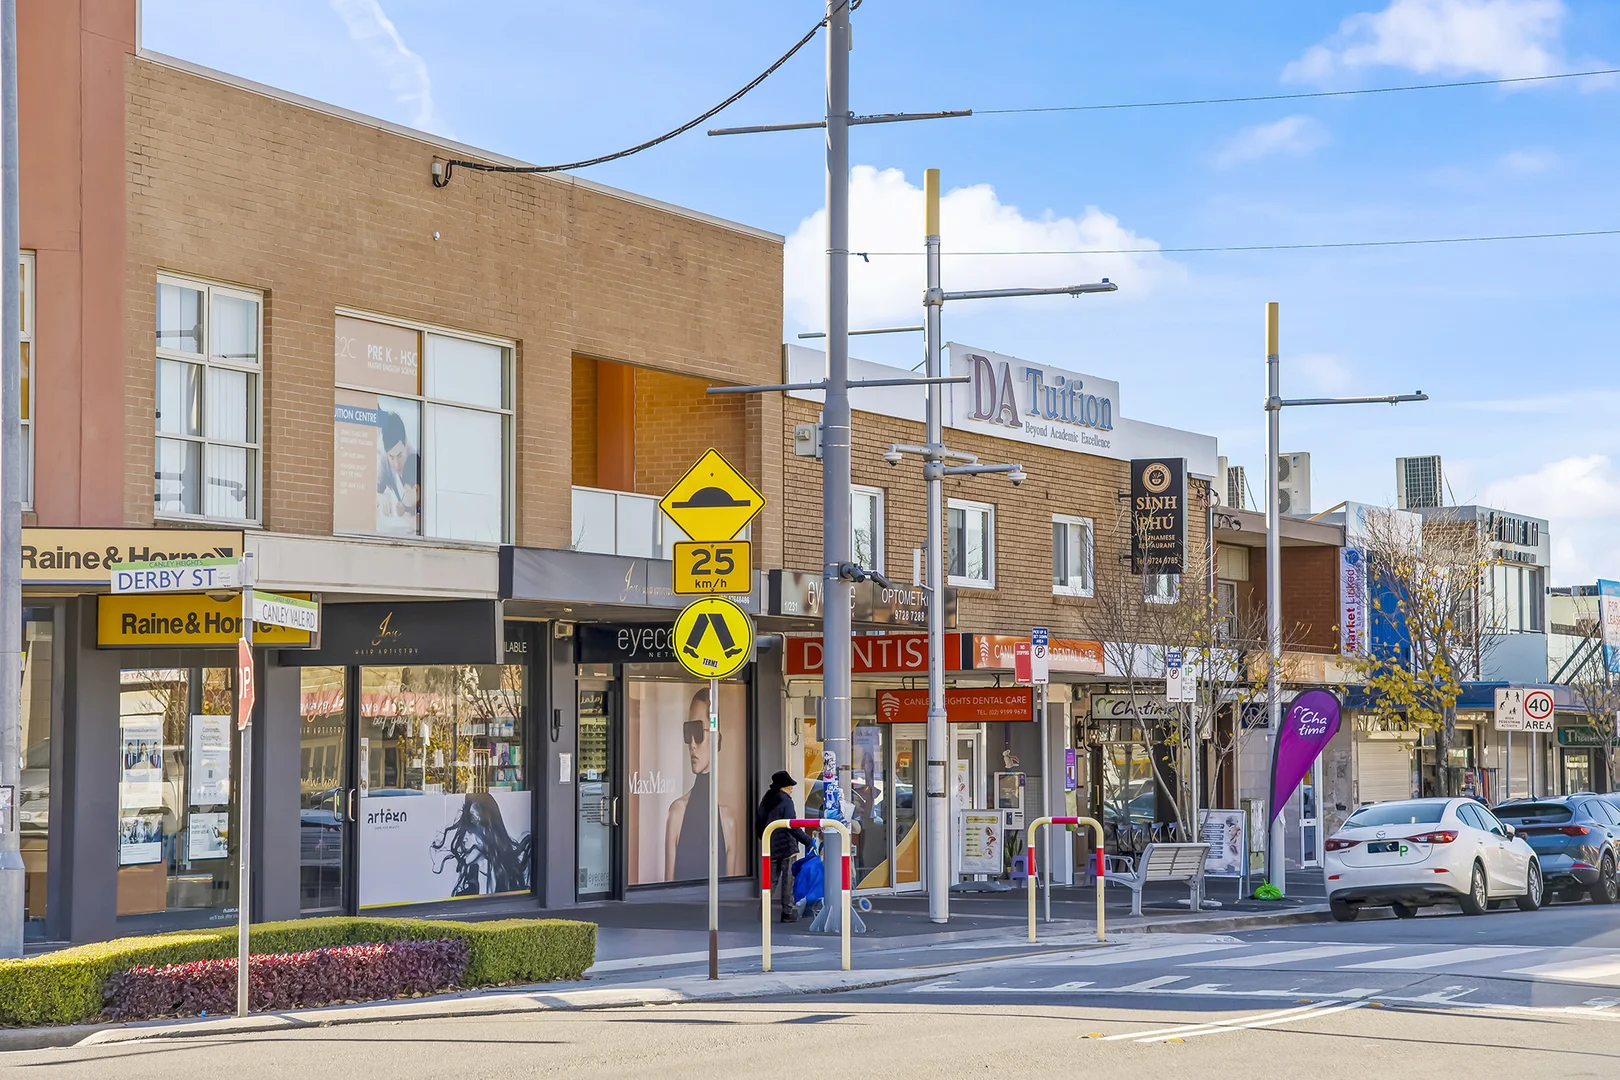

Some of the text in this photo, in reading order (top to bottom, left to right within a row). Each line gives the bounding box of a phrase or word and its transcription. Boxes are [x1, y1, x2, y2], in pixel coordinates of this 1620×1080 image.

[367, 344, 383, 361] PRE
[385, 347, 392, 362] K
[400, 350, 418, 367] HSC
[967, 353, 1113, 432] DA Tuition
[355, 411, 377, 423] CENTRE
[1025, 421, 1111, 449] Beyond Academic Excellence
[1136, 496, 1178, 511] SINH
[149, 559, 204, 568] CANLEY HEIGHTS
[690, 548, 735, 576] 25
[118, 570, 185, 590] DERBY
[191, 568, 217, 587] ST
[694, 579, 727, 590] km/h
[1346, 569, 1355, 605] Linked
[1608, 601, 1618, 612] FOR
[262, 604, 316, 629] CANLEY VALE RD
[894, 609, 910, 620] 9728
[205, 611, 272, 634] Hore
[803, 638, 929, 671] DNTIS
[1052, 647, 1079, 662] DENTAL
[1079, 649, 1097, 662] CARE
[972, 696, 1003, 705] DENTAL
[1005, 695, 1027, 704] CARE
[1528, 698, 1550, 713] 40
[1300, 711, 1327, 725] Cha
[1525, 721, 1553, 730] AREA
[1298, 723, 1326, 736] time
[1399, 845, 1409, 857] P
